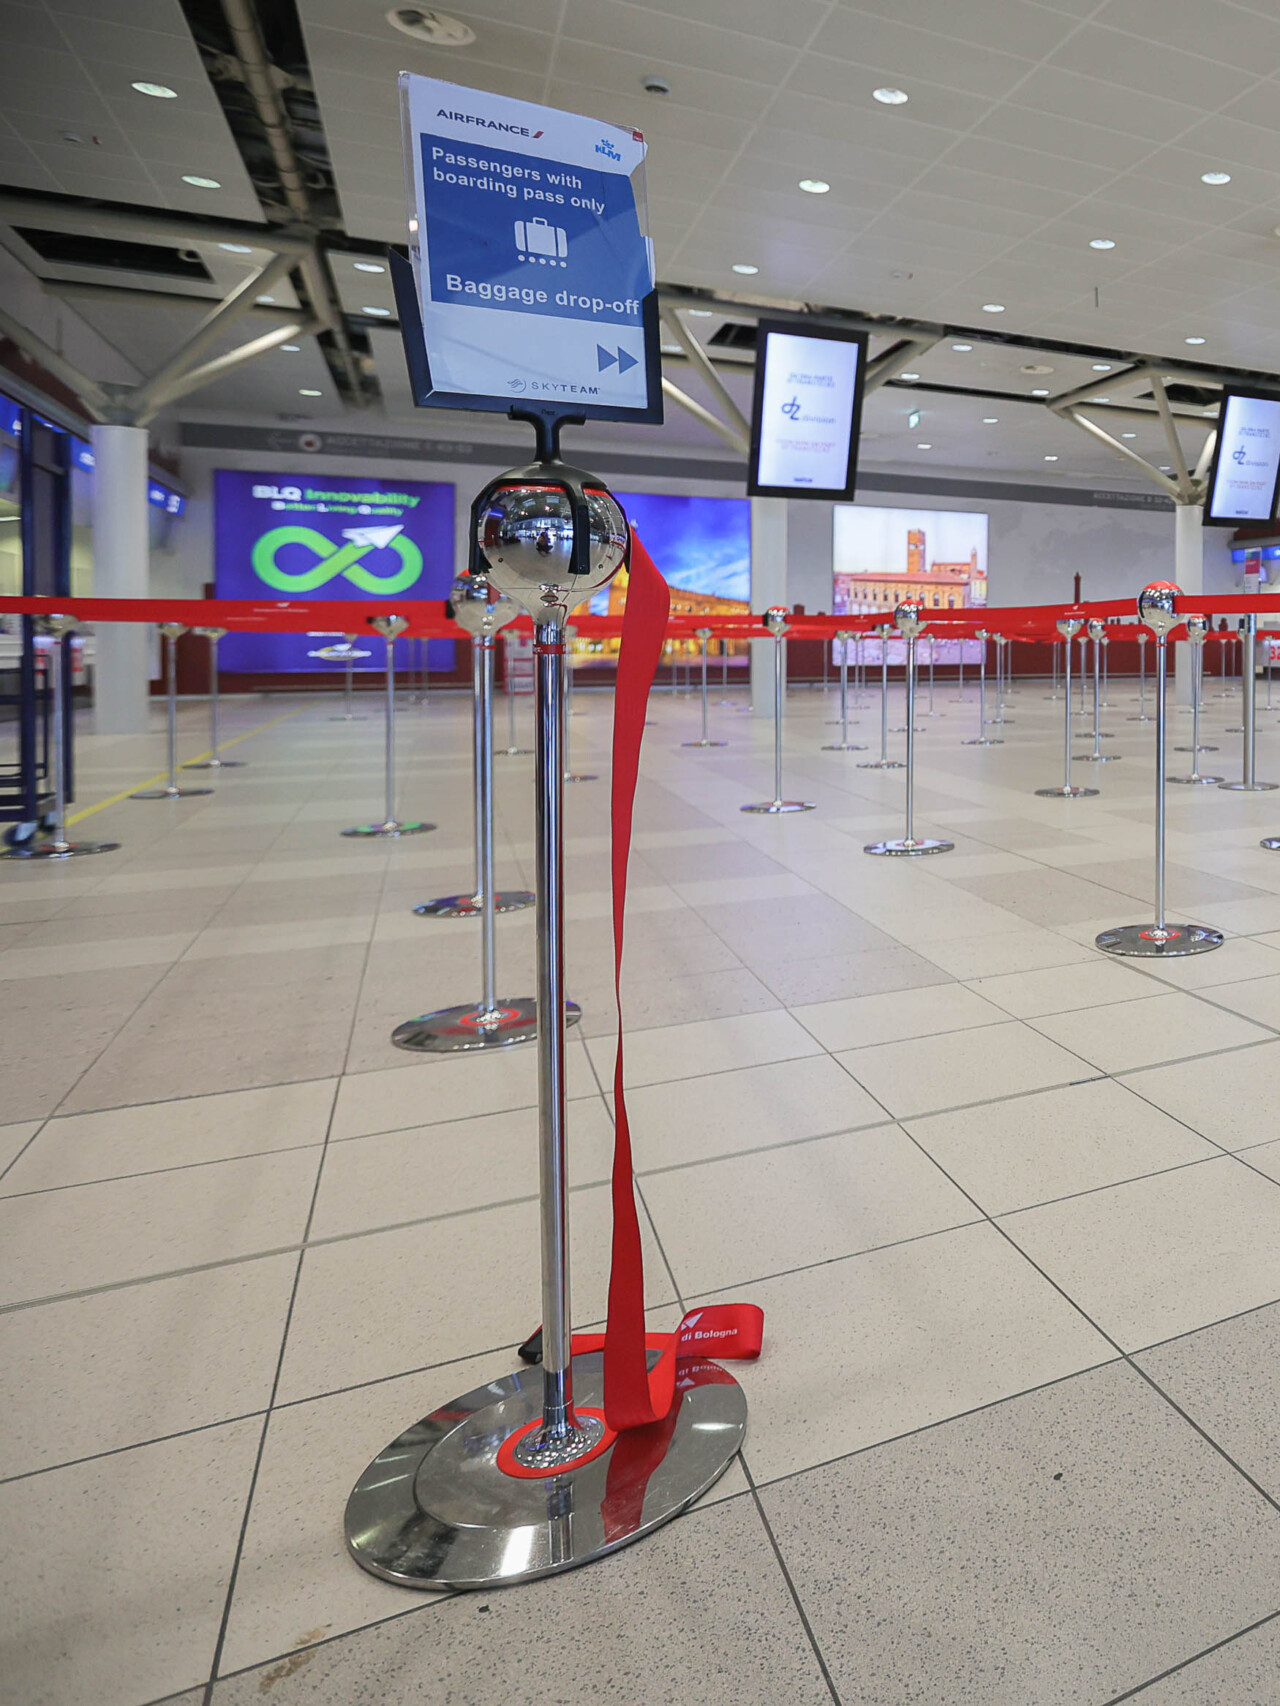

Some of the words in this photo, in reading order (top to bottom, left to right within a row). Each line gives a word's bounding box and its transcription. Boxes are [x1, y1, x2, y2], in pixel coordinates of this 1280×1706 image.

[436, 109, 530, 137] AIRFRANCE
[595, 144, 621, 162] KLM
[432, 147, 541, 181] Passengers
[546, 172, 582, 190] with
[433, 167, 518, 198] boarding
[523, 187, 565, 205] pass
[570, 196, 606, 215] only
[446, 274, 548, 305] Baggage
[555, 290, 640, 316] drop-off
[531, 381, 599, 395] SKYTEAM
[252, 484, 302, 501] BLQ
[304, 488, 421, 509] Innovability
[681, 1332, 692, 1342] di
[694, 1328, 738, 1340] Bologna
